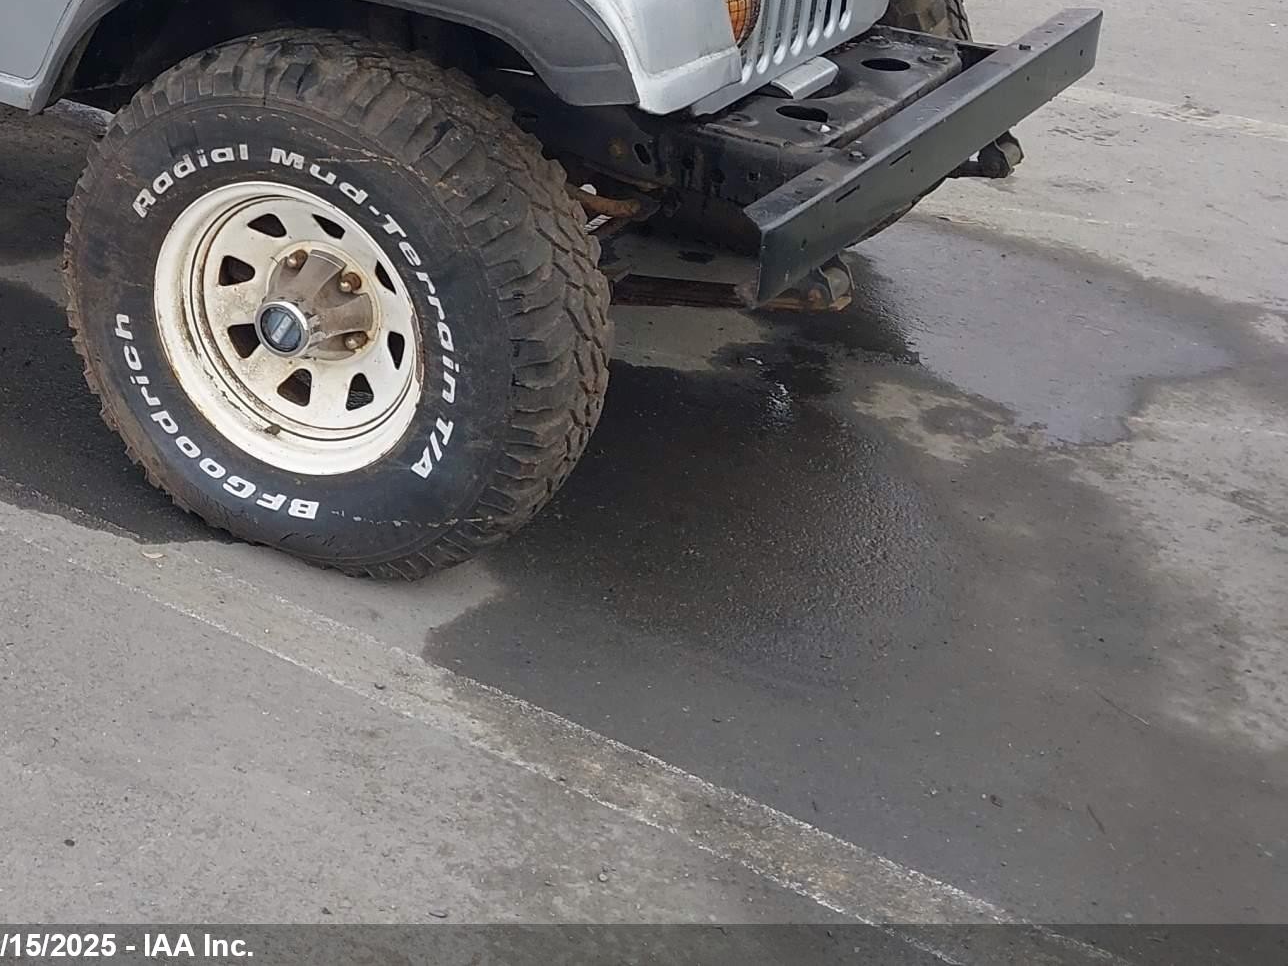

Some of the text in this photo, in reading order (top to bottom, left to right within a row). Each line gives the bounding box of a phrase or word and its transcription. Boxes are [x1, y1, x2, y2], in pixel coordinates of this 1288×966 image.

[114, 313, 320, 521] BFGoodrich
[131, 144, 461, 481] Radial Mud-Terrain T/A
